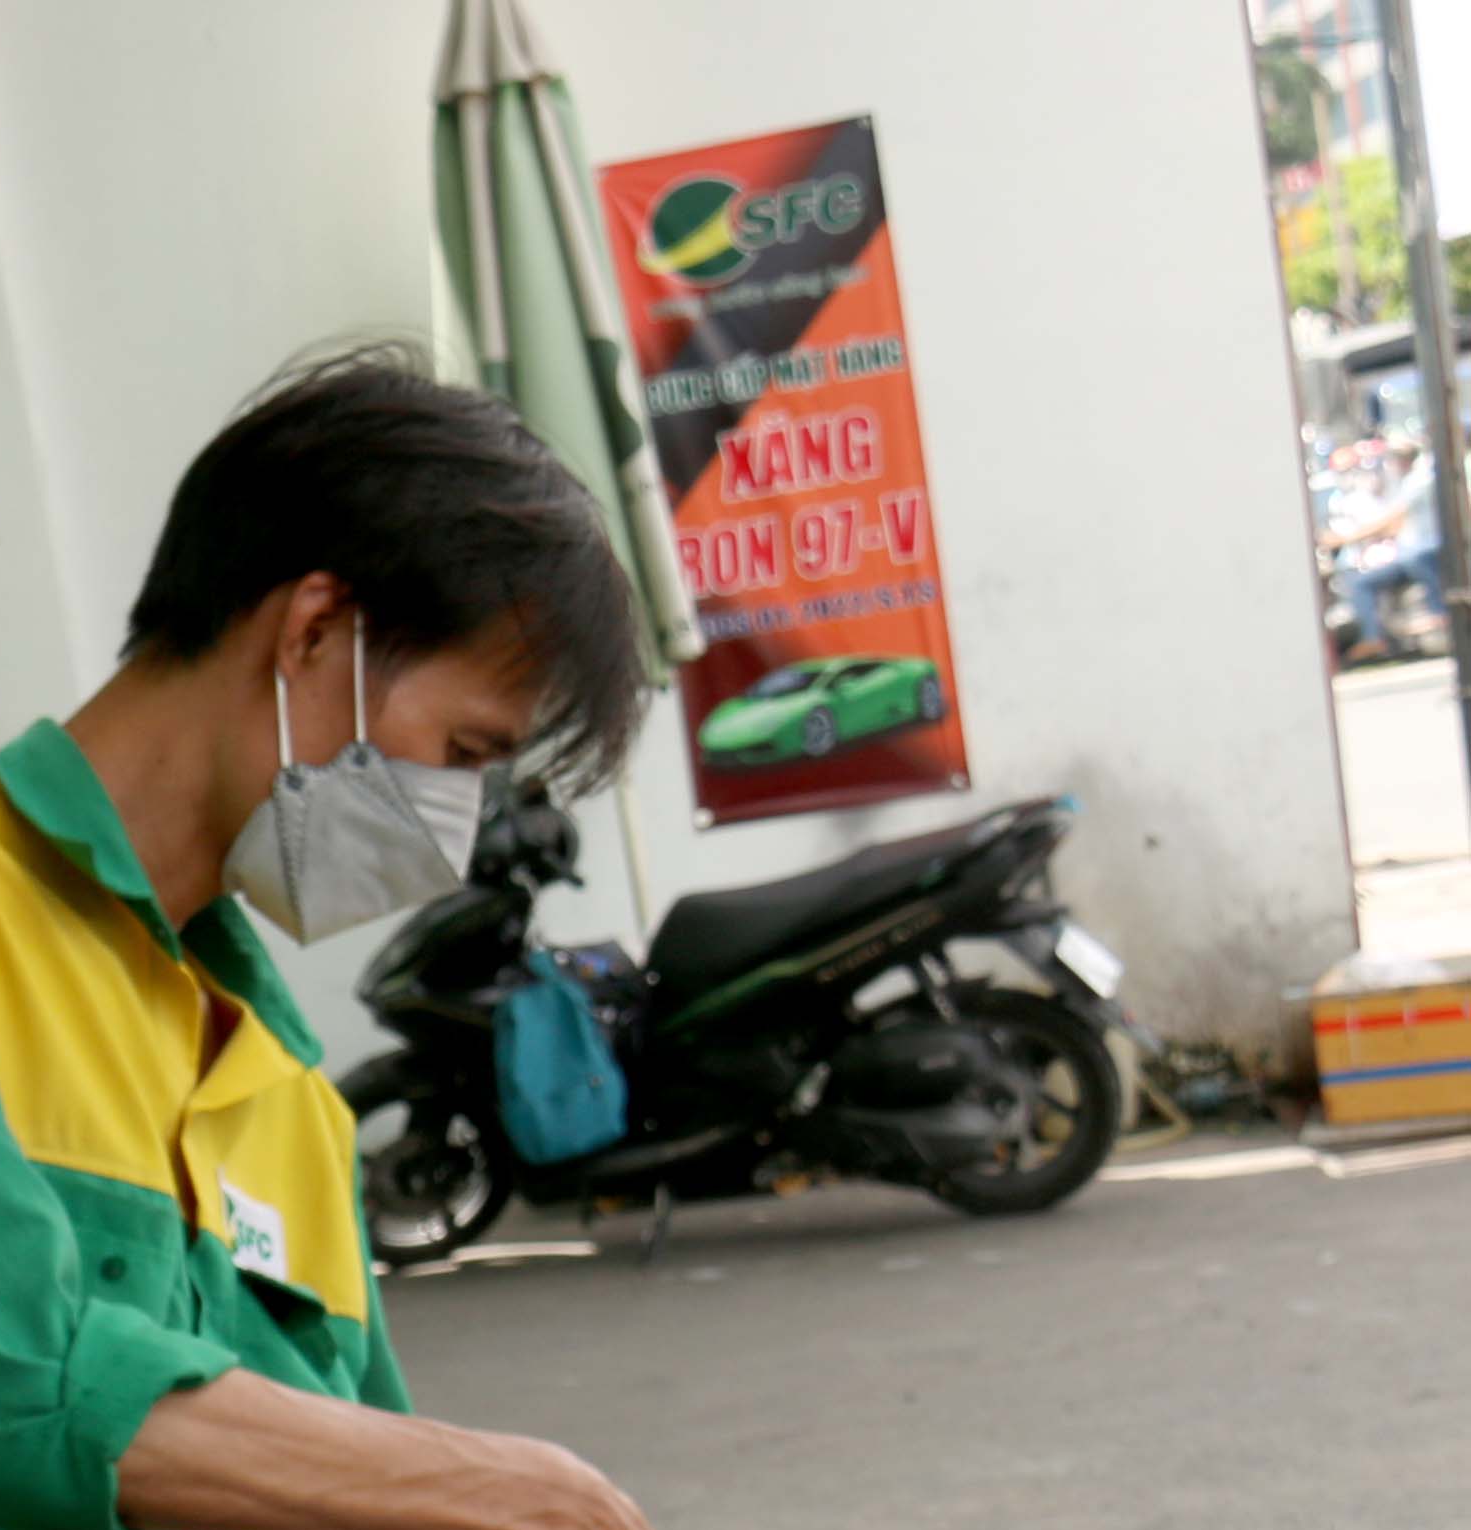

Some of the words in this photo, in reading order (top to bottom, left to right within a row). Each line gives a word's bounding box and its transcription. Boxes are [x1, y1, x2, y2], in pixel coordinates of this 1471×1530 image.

[732, 174, 863, 247] SFC
[719, 410, 879, 496] XĂNG
[676, 520, 781, 595] RON
